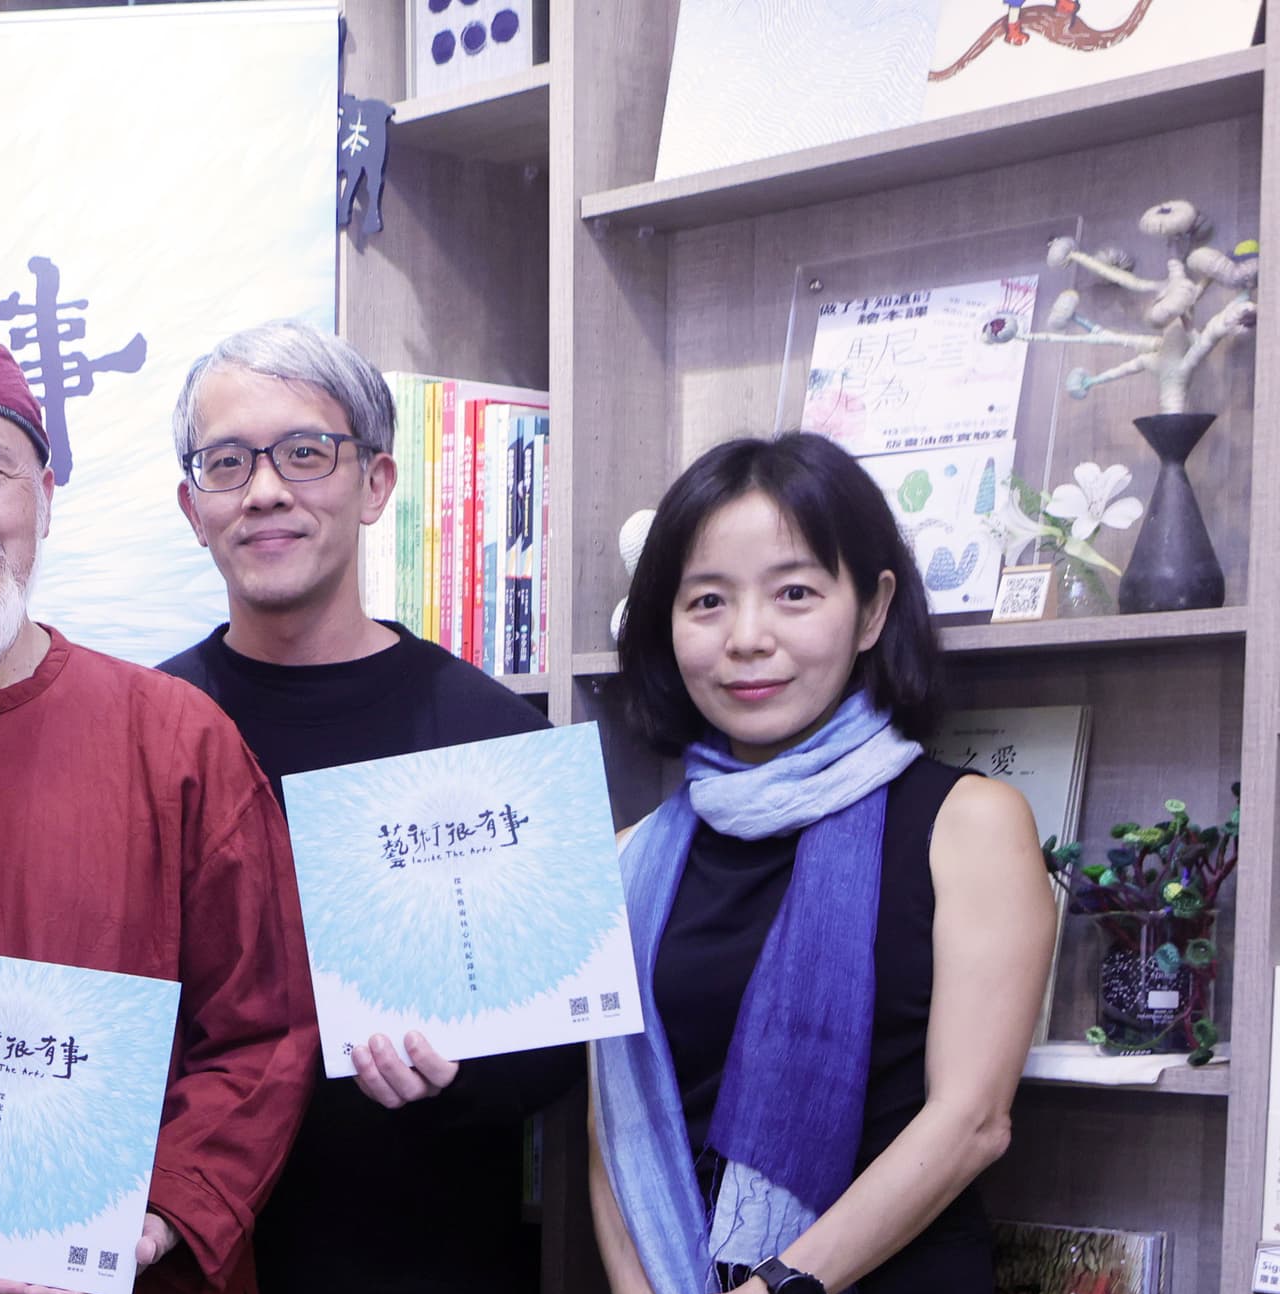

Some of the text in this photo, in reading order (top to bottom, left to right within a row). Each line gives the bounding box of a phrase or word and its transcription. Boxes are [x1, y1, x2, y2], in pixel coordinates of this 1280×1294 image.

[378, 804, 529, 869] 藝術很有事
[1262, 1260, 1280, 1275] Sig
